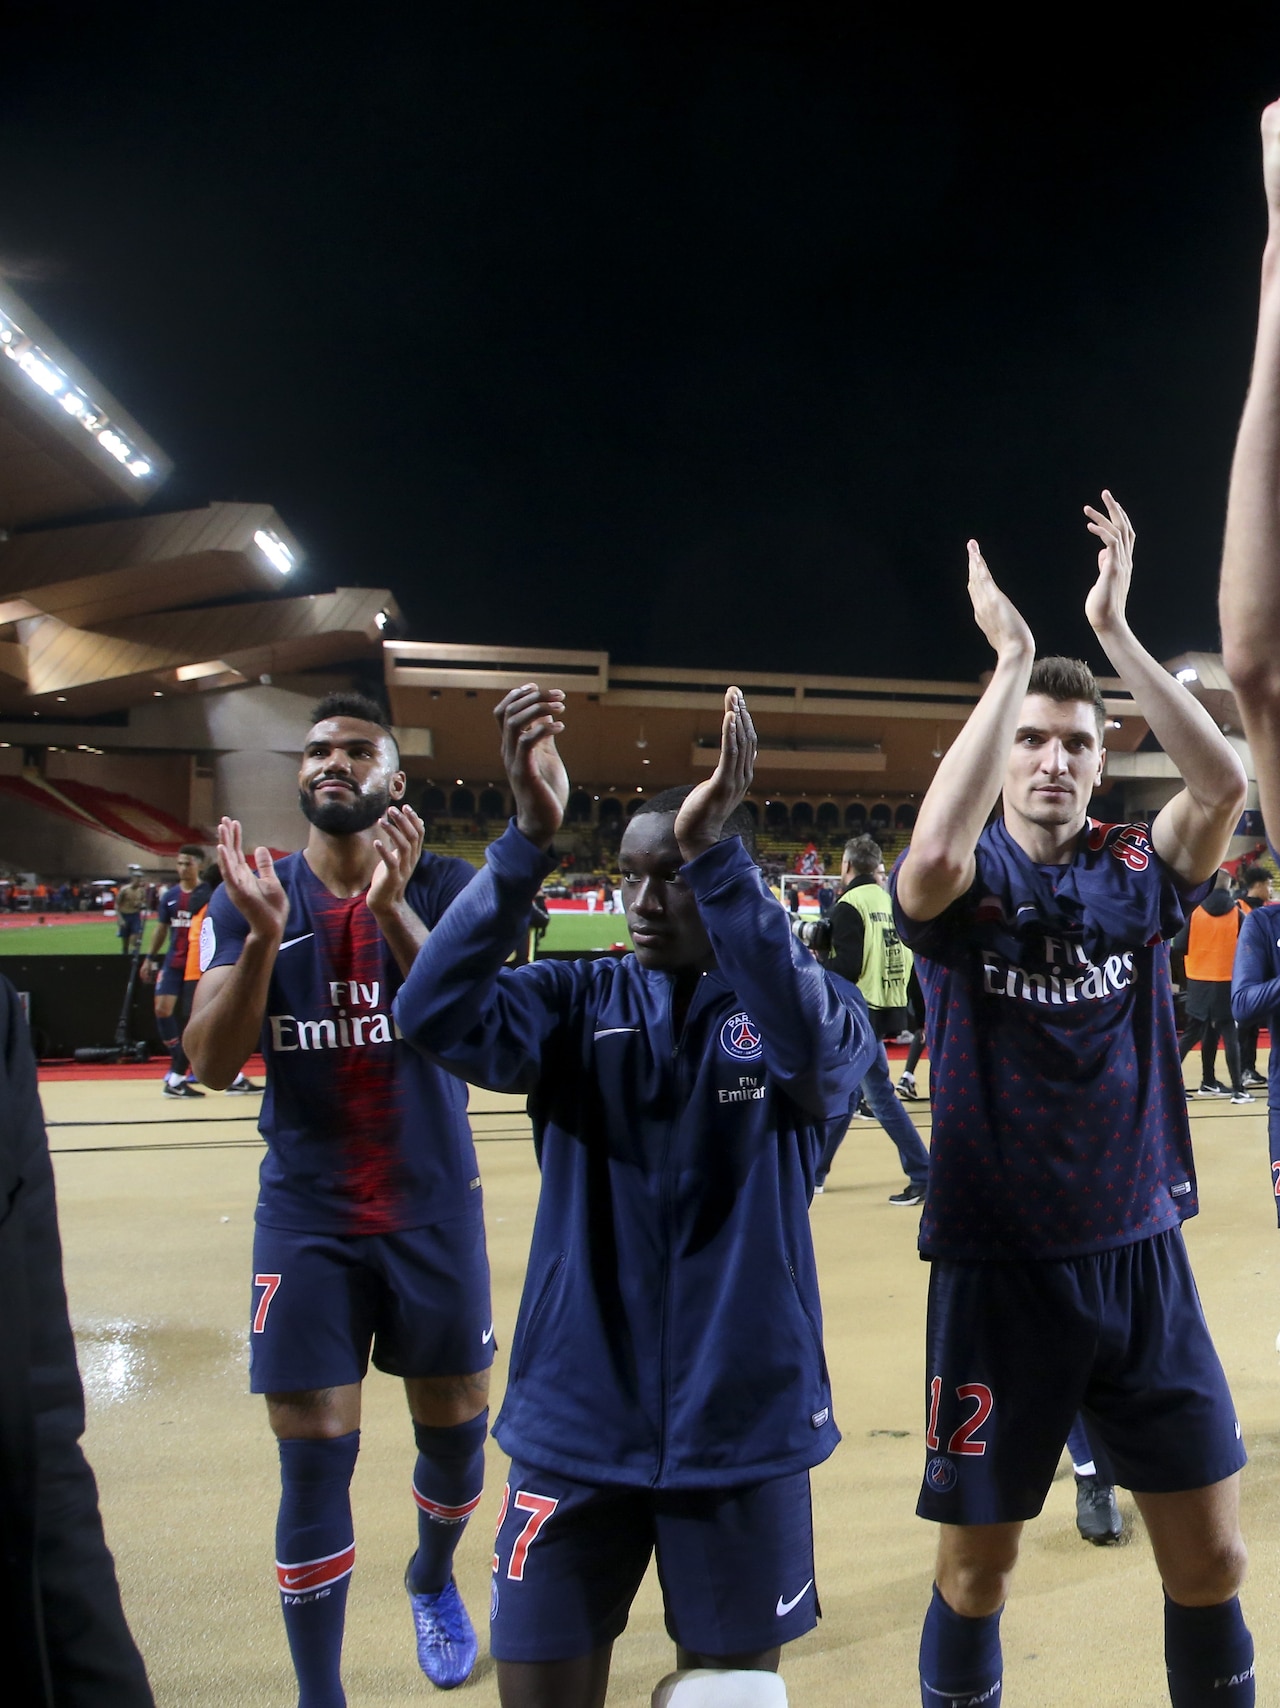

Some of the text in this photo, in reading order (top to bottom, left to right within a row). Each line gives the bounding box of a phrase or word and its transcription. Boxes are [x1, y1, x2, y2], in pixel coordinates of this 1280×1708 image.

[328, 980, 380, 1009] Fly
[728, 1014, 752, 1028] PAR
[739, 1077, 758, 1087] Fly
[253, 1273, 282, 1334] 7
[926, 1375, 994, 1456] 12
[284, 1588, 332, 1605] PARIS
